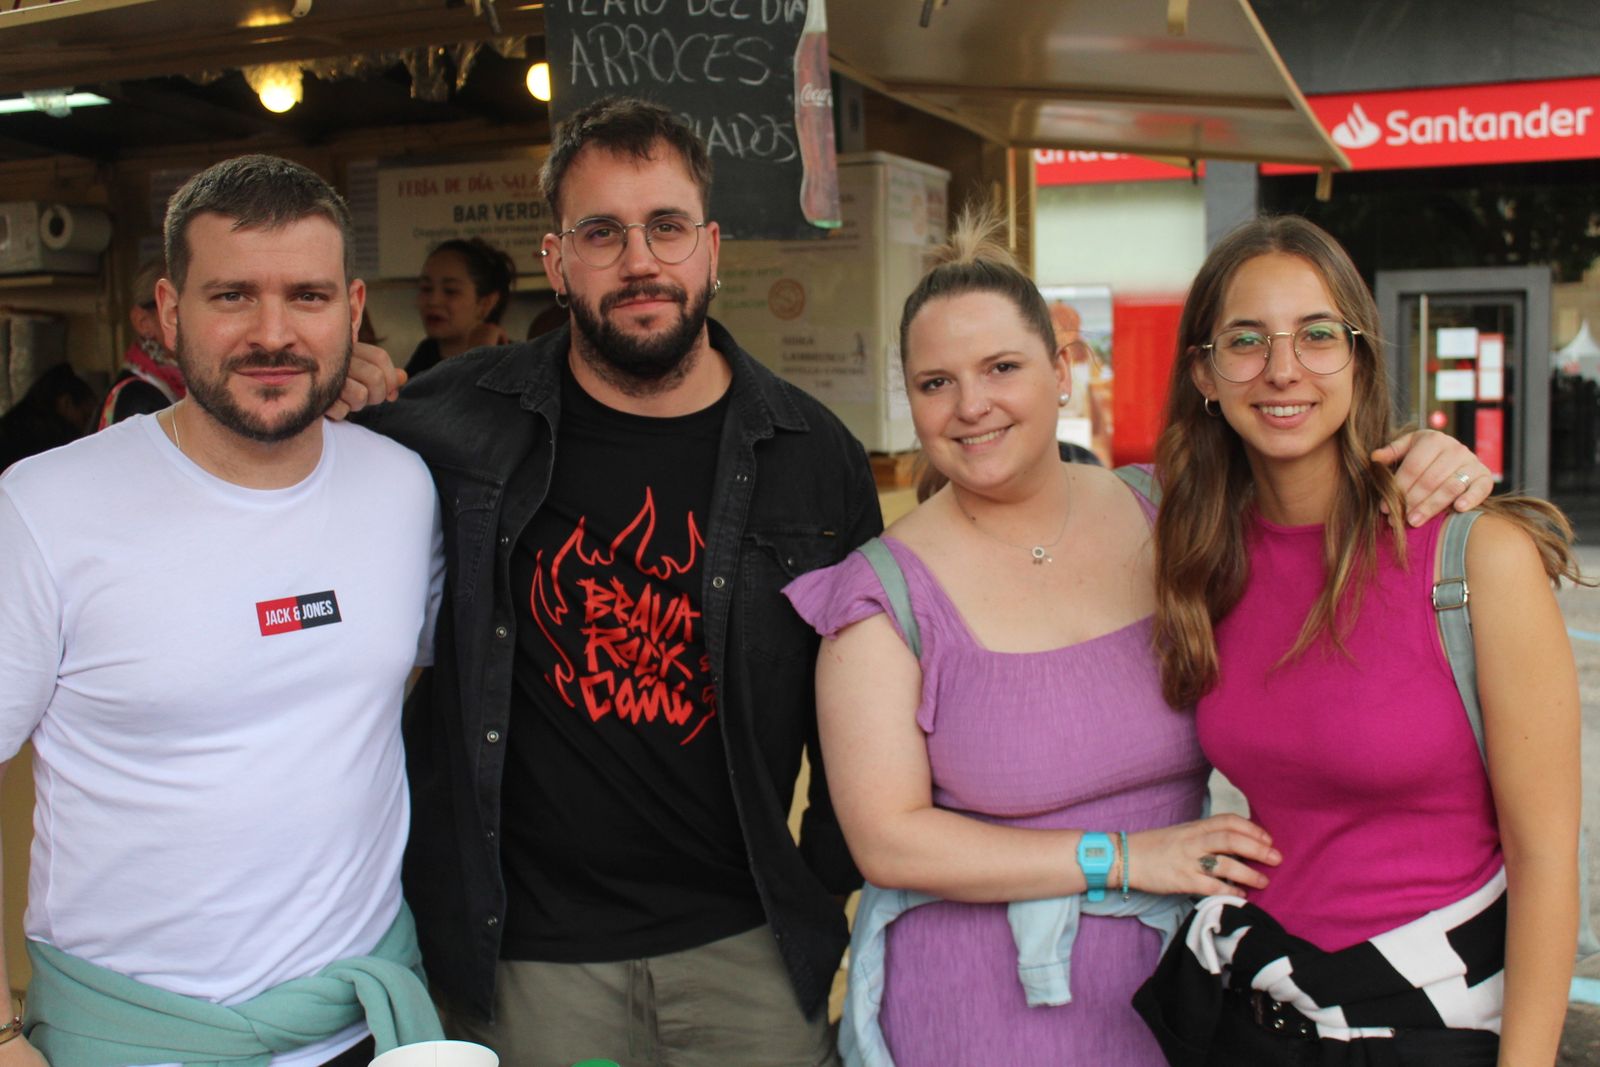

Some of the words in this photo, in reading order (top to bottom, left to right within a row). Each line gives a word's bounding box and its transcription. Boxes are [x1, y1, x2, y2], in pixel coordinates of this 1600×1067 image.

[570, 23, 774, 88] ARROCES
[1385, 102, 1594, 147] Santander
[454, 204, 489, 223] BAR
[265, 607, 292, 627] JACK
[293, 606, 301, 621] &
[302, 600, 334, 620] JONES
[576, 576, 701, 644] BRAVA
